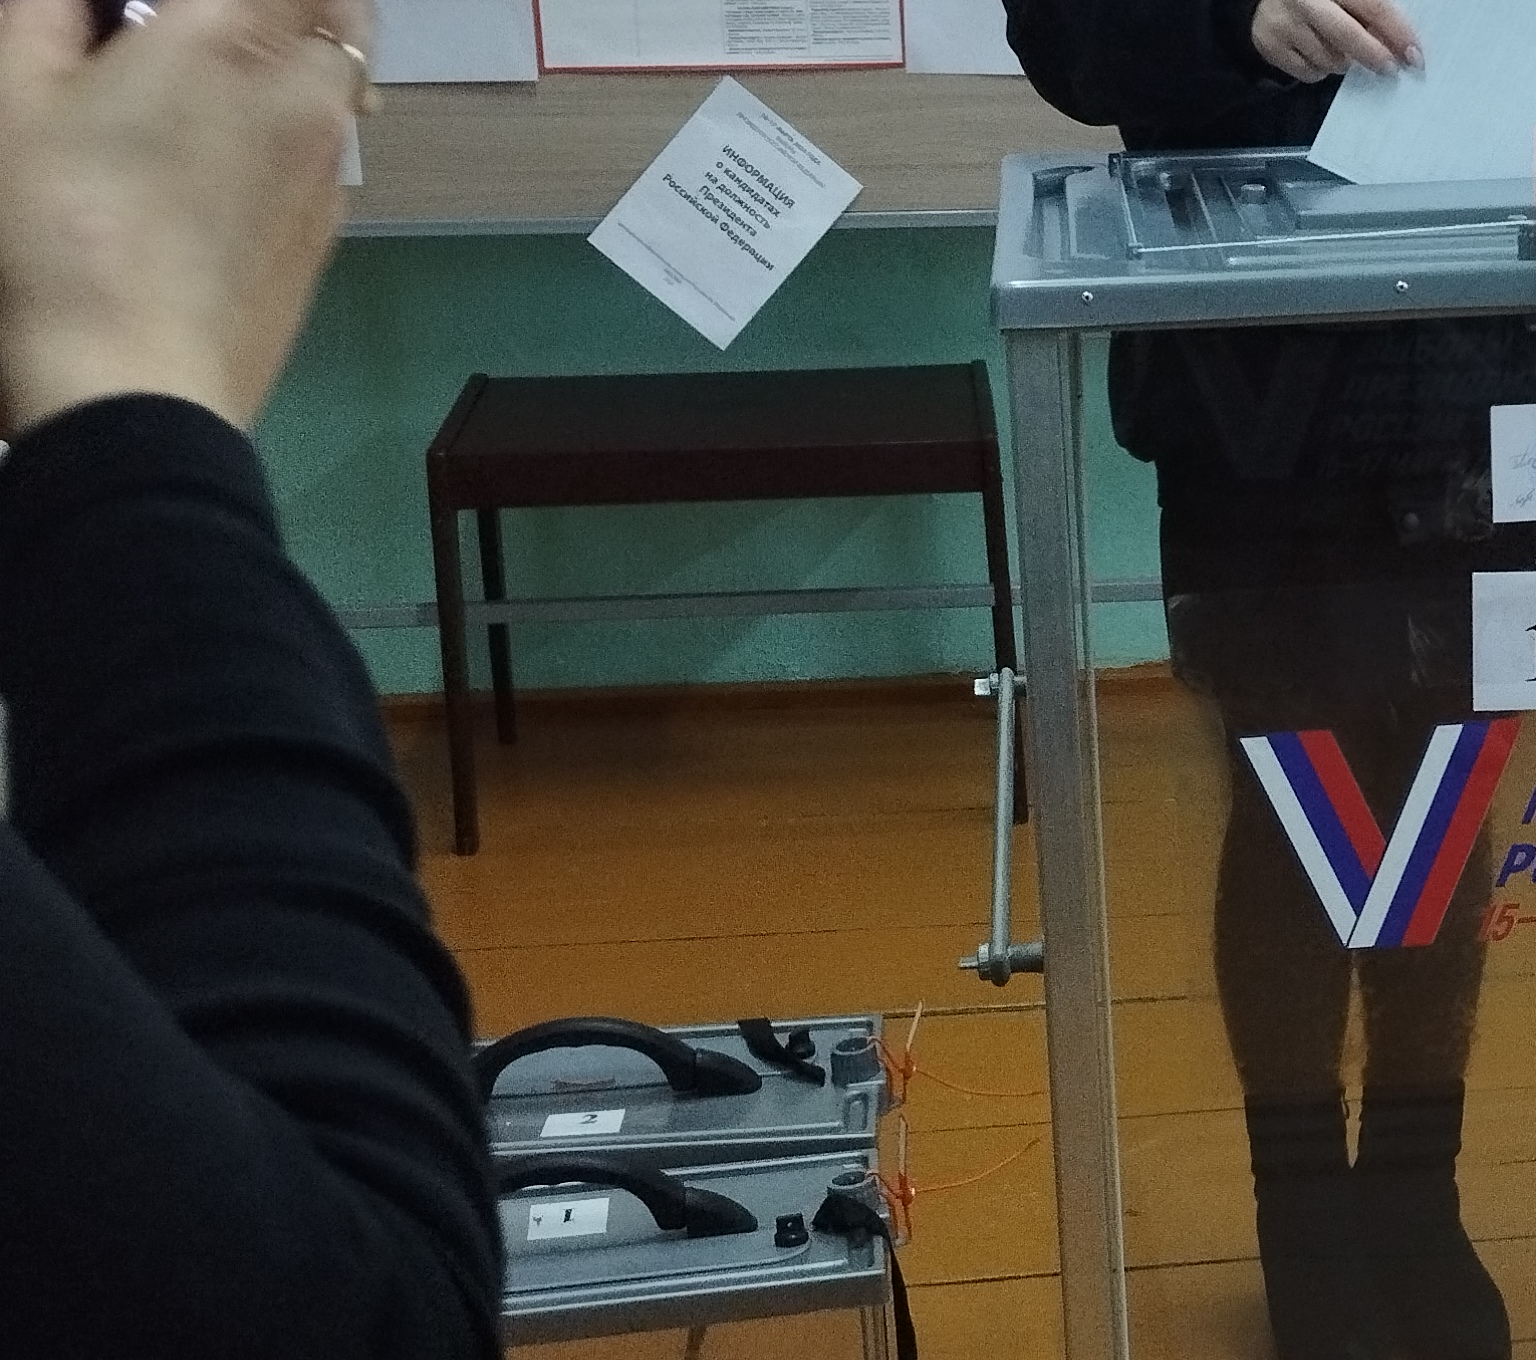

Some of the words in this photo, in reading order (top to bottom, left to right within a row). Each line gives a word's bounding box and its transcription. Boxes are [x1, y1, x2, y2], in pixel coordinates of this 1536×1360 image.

[704, 171, 719, 185] на
[717, 182, 771, 229] должность
[721, 143, 796, 209] ИНФОРМАЦИЯ
[723, 165, 782, 218] кандидатах
[662, 173, 719, 225] Российской
[719, 221, 775, 271] Федерации
[699, 185, 757, 237] Президента
